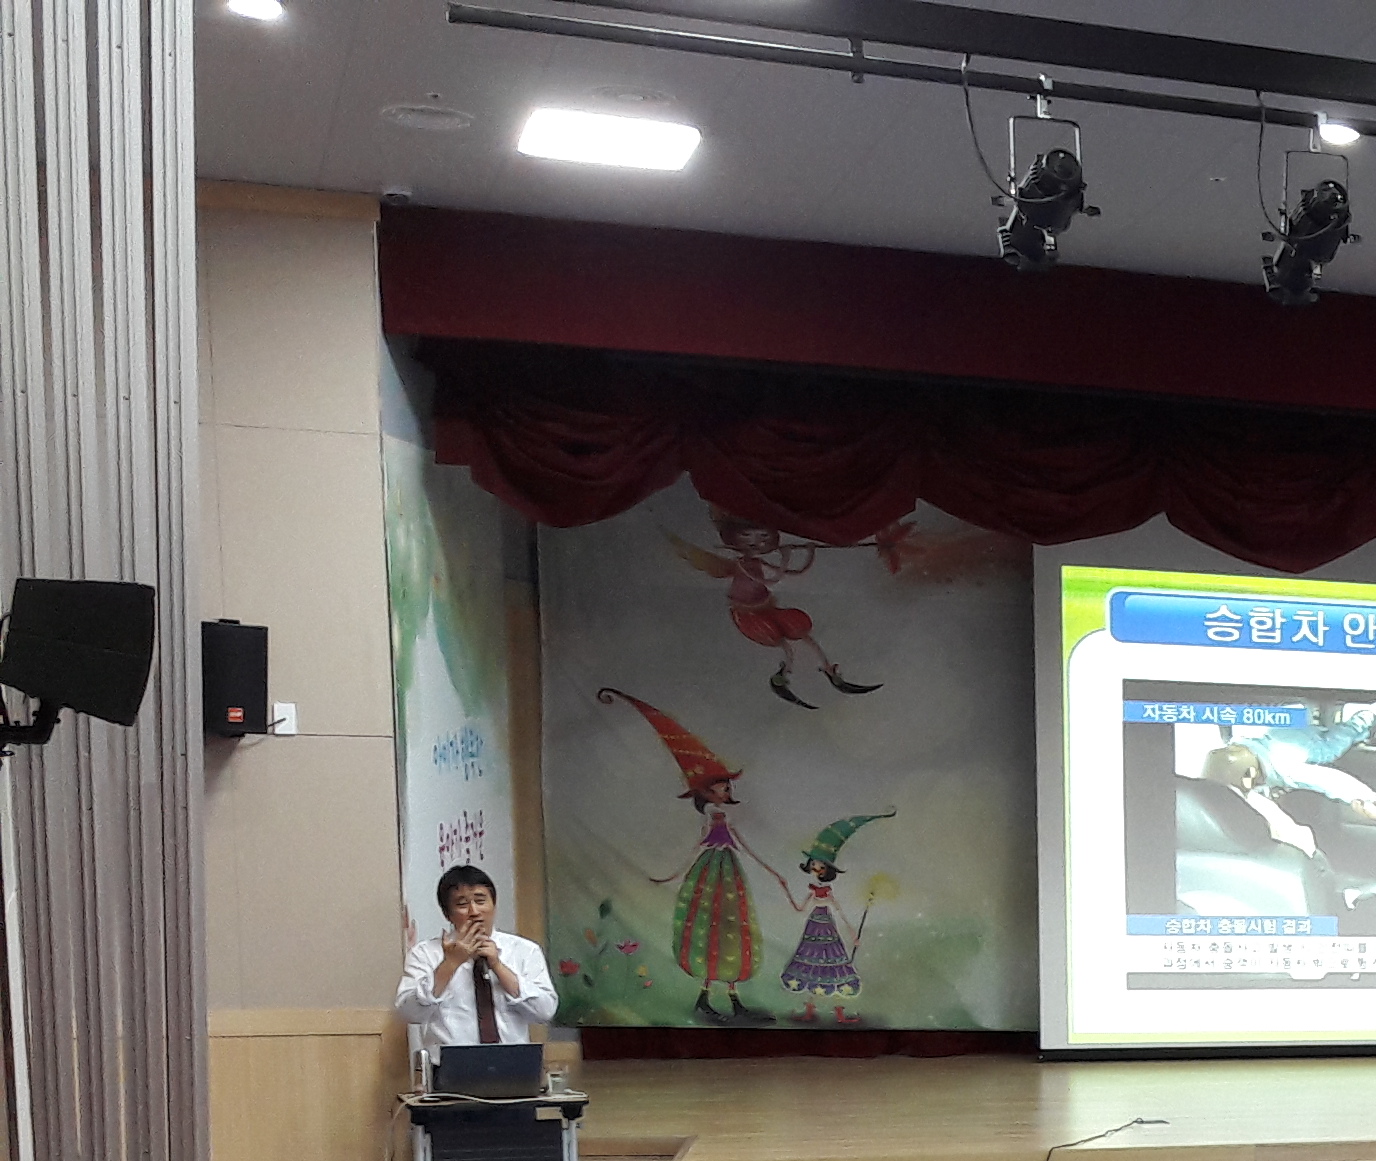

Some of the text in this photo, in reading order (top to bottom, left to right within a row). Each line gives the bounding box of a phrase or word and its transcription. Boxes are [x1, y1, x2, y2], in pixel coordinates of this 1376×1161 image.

[1203, 604, 1330, 647] 승합차
[1143, 703, 1291, 725] 자동차 시속 80km
[1165, 919, 1212, 934] 승합차
[1282, 919, 1313, 934] 결과
